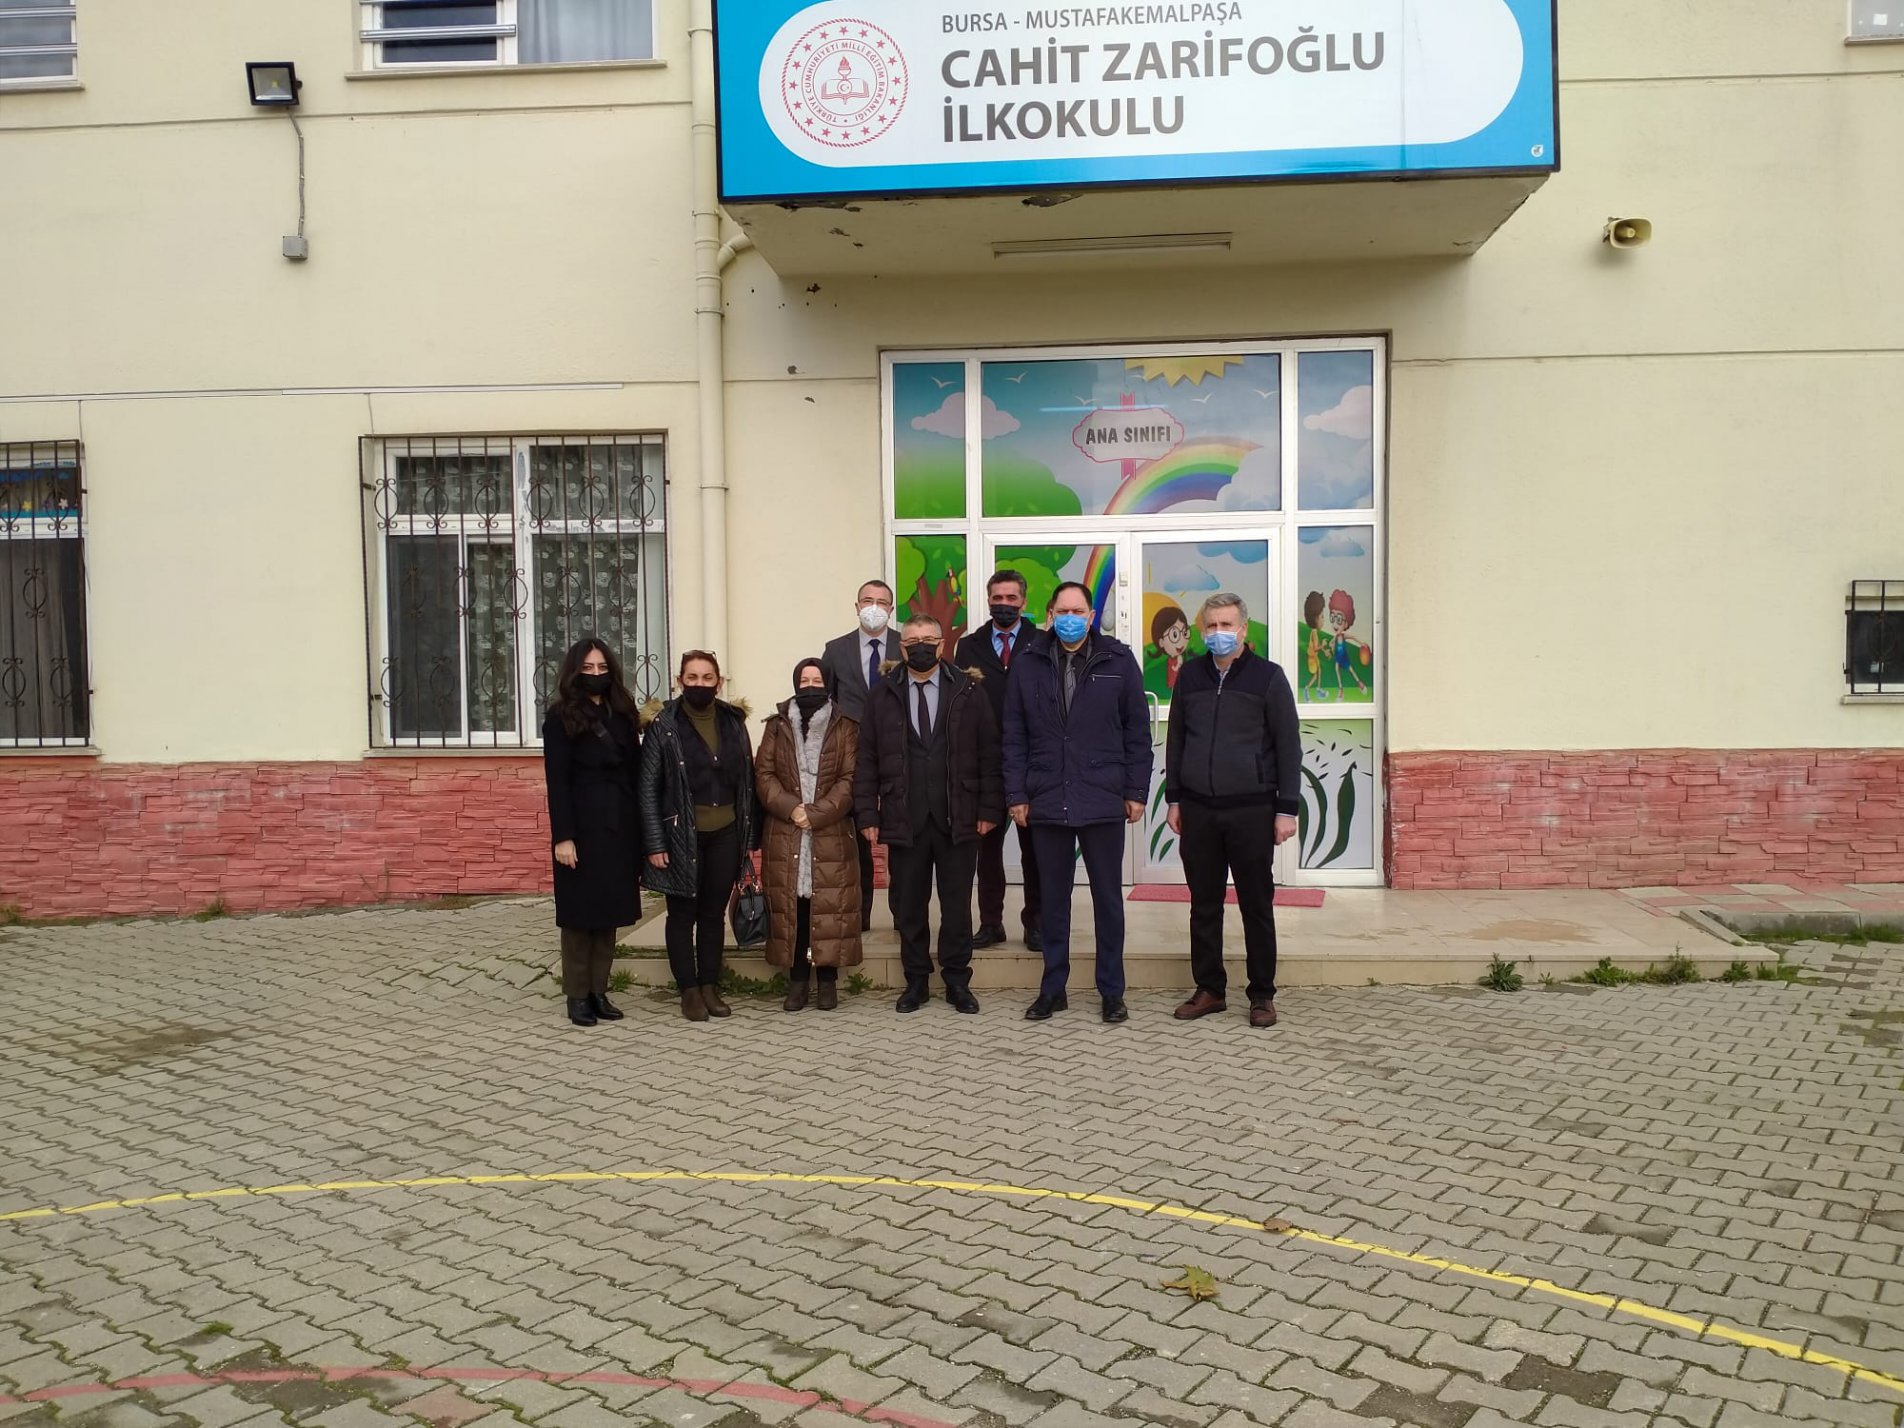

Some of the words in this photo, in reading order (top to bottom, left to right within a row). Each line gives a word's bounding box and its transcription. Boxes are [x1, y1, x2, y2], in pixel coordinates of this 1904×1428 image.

[942, 12, 1008, 33] BURSA
[1026, 1, 1242, 29] MUSTAFAKEMALPAŞA
[841, 41, 865, 52] MİLLİ
[941, 36, 1090, 88] CAHİT
[1102, 25, 1384, 82] ZARİFOĞLU
[805, 44, 839, 94] CUMHURİYETİ
[865, 50, 885, 78] EĞİTİM
[808, 95, 837, 123] TÜRKİYE
[855, 81, 885, 122] BAKANLIĞI
[943, 95, 1184, 142] İLKOKULU
[1086, 428, 1118, 445] ANA
[1124, 426, 1171, 443] SINIFI
